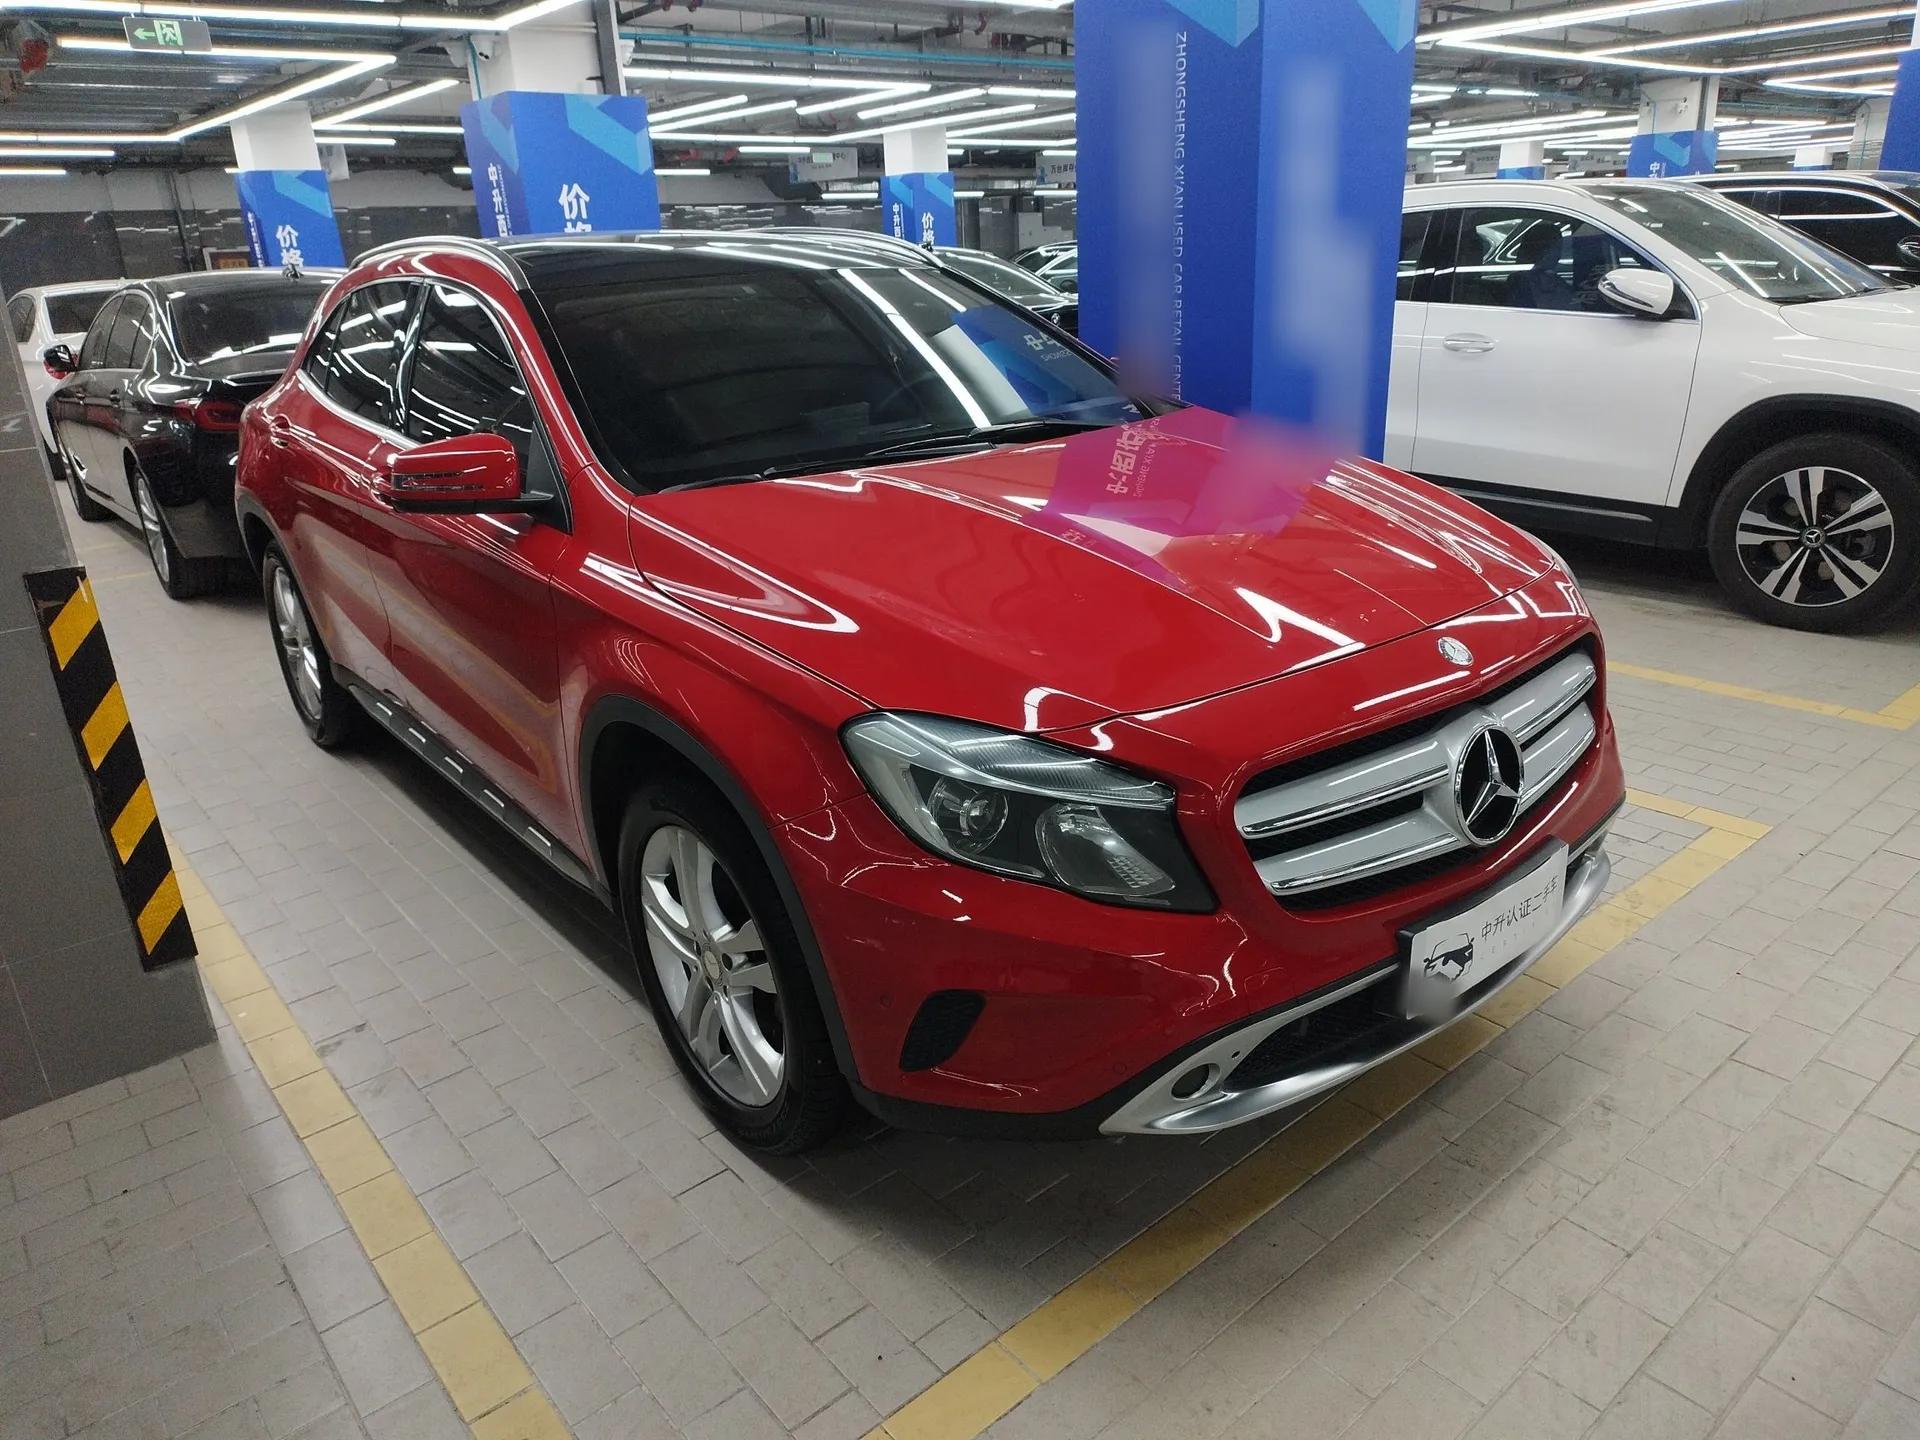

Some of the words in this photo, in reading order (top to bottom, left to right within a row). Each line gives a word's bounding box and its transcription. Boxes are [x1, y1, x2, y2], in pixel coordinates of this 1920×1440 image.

[1174, 31, 1188, 158] ZHONGSHENG
[1172, 214, 1184, 258] USED
[1172, 263, 1183, 295] CAR
[1481, 875, 1559, 942] 中升认证二手车
